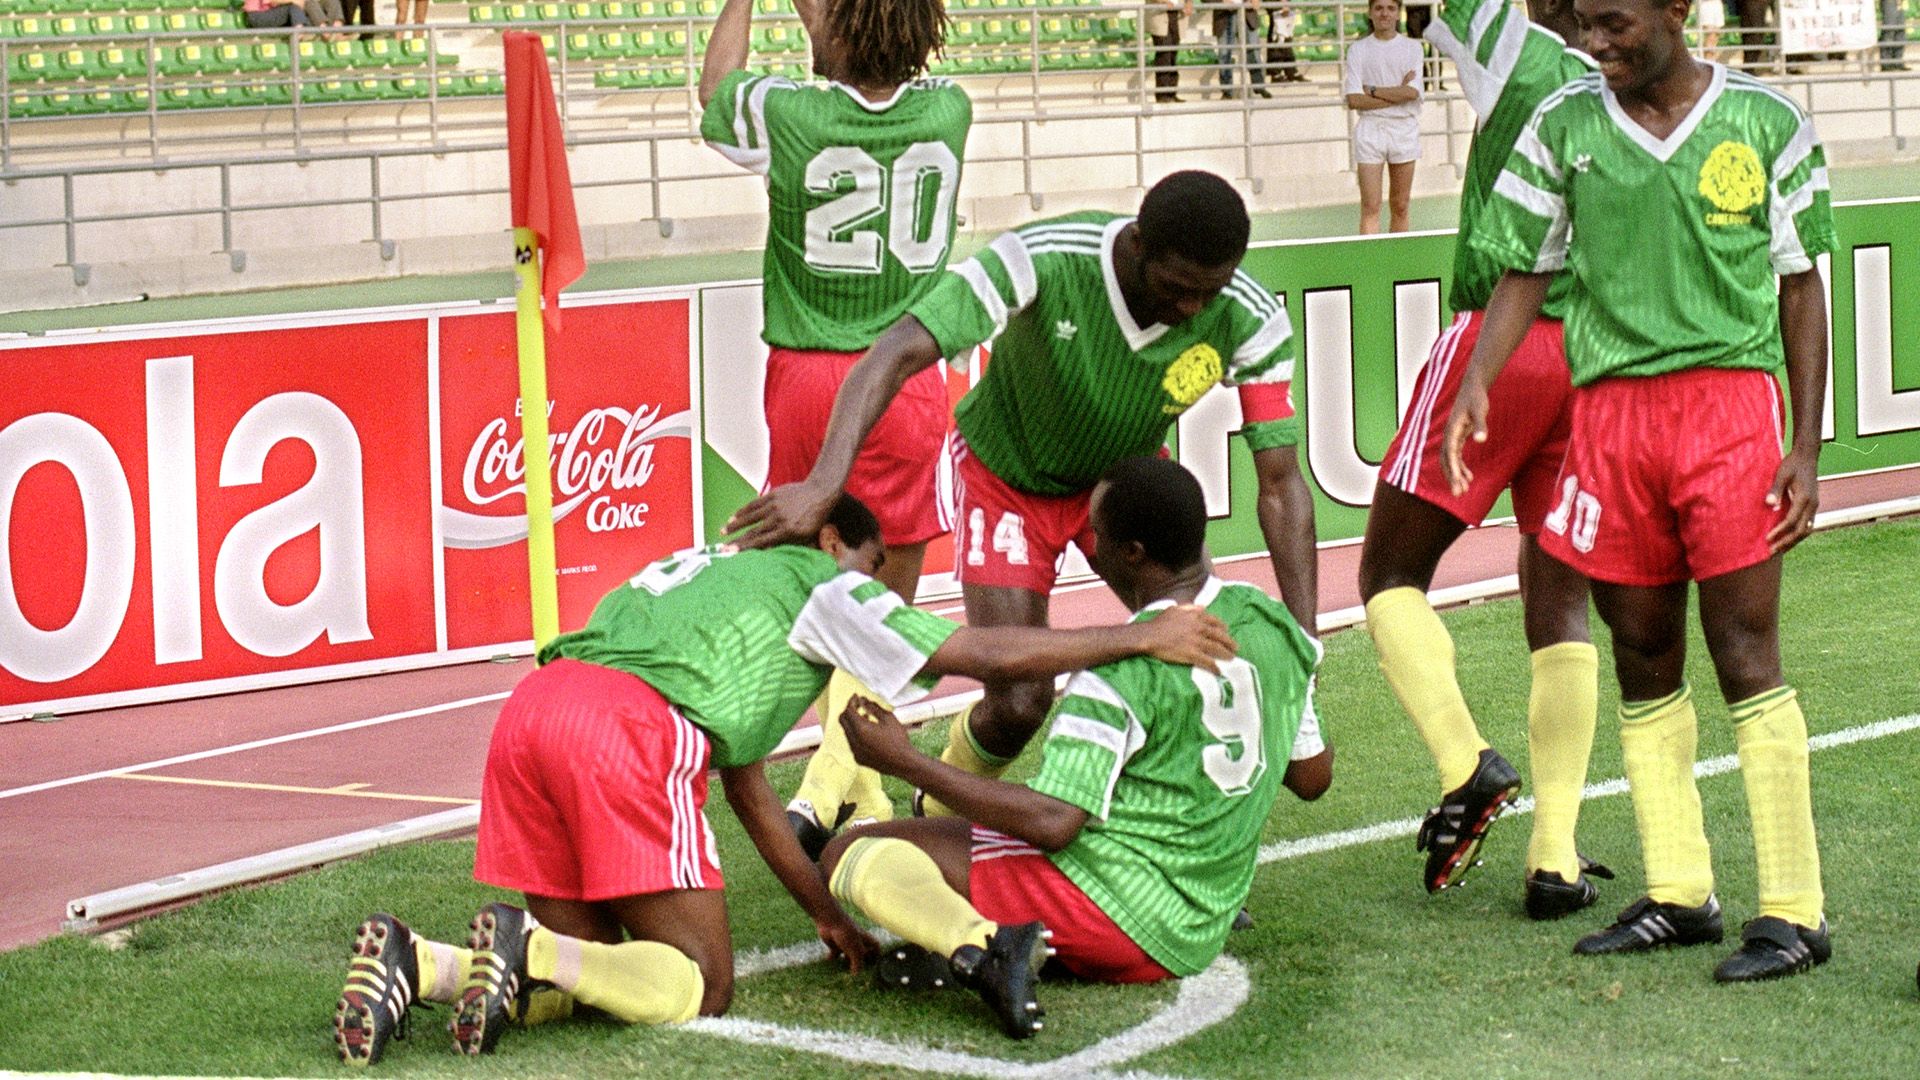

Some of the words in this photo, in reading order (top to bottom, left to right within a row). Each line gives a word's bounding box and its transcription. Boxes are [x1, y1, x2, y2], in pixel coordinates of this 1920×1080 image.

[803, 140, 959, 275] 20
[463, 404, 661, 504] Coc-Cola
[586, 496, 648, 532] Coke
[967, 507, 1029, 566] 14
[1545, 474, 1602, 554] 10
[1194, 657, 1267, 798] 9
